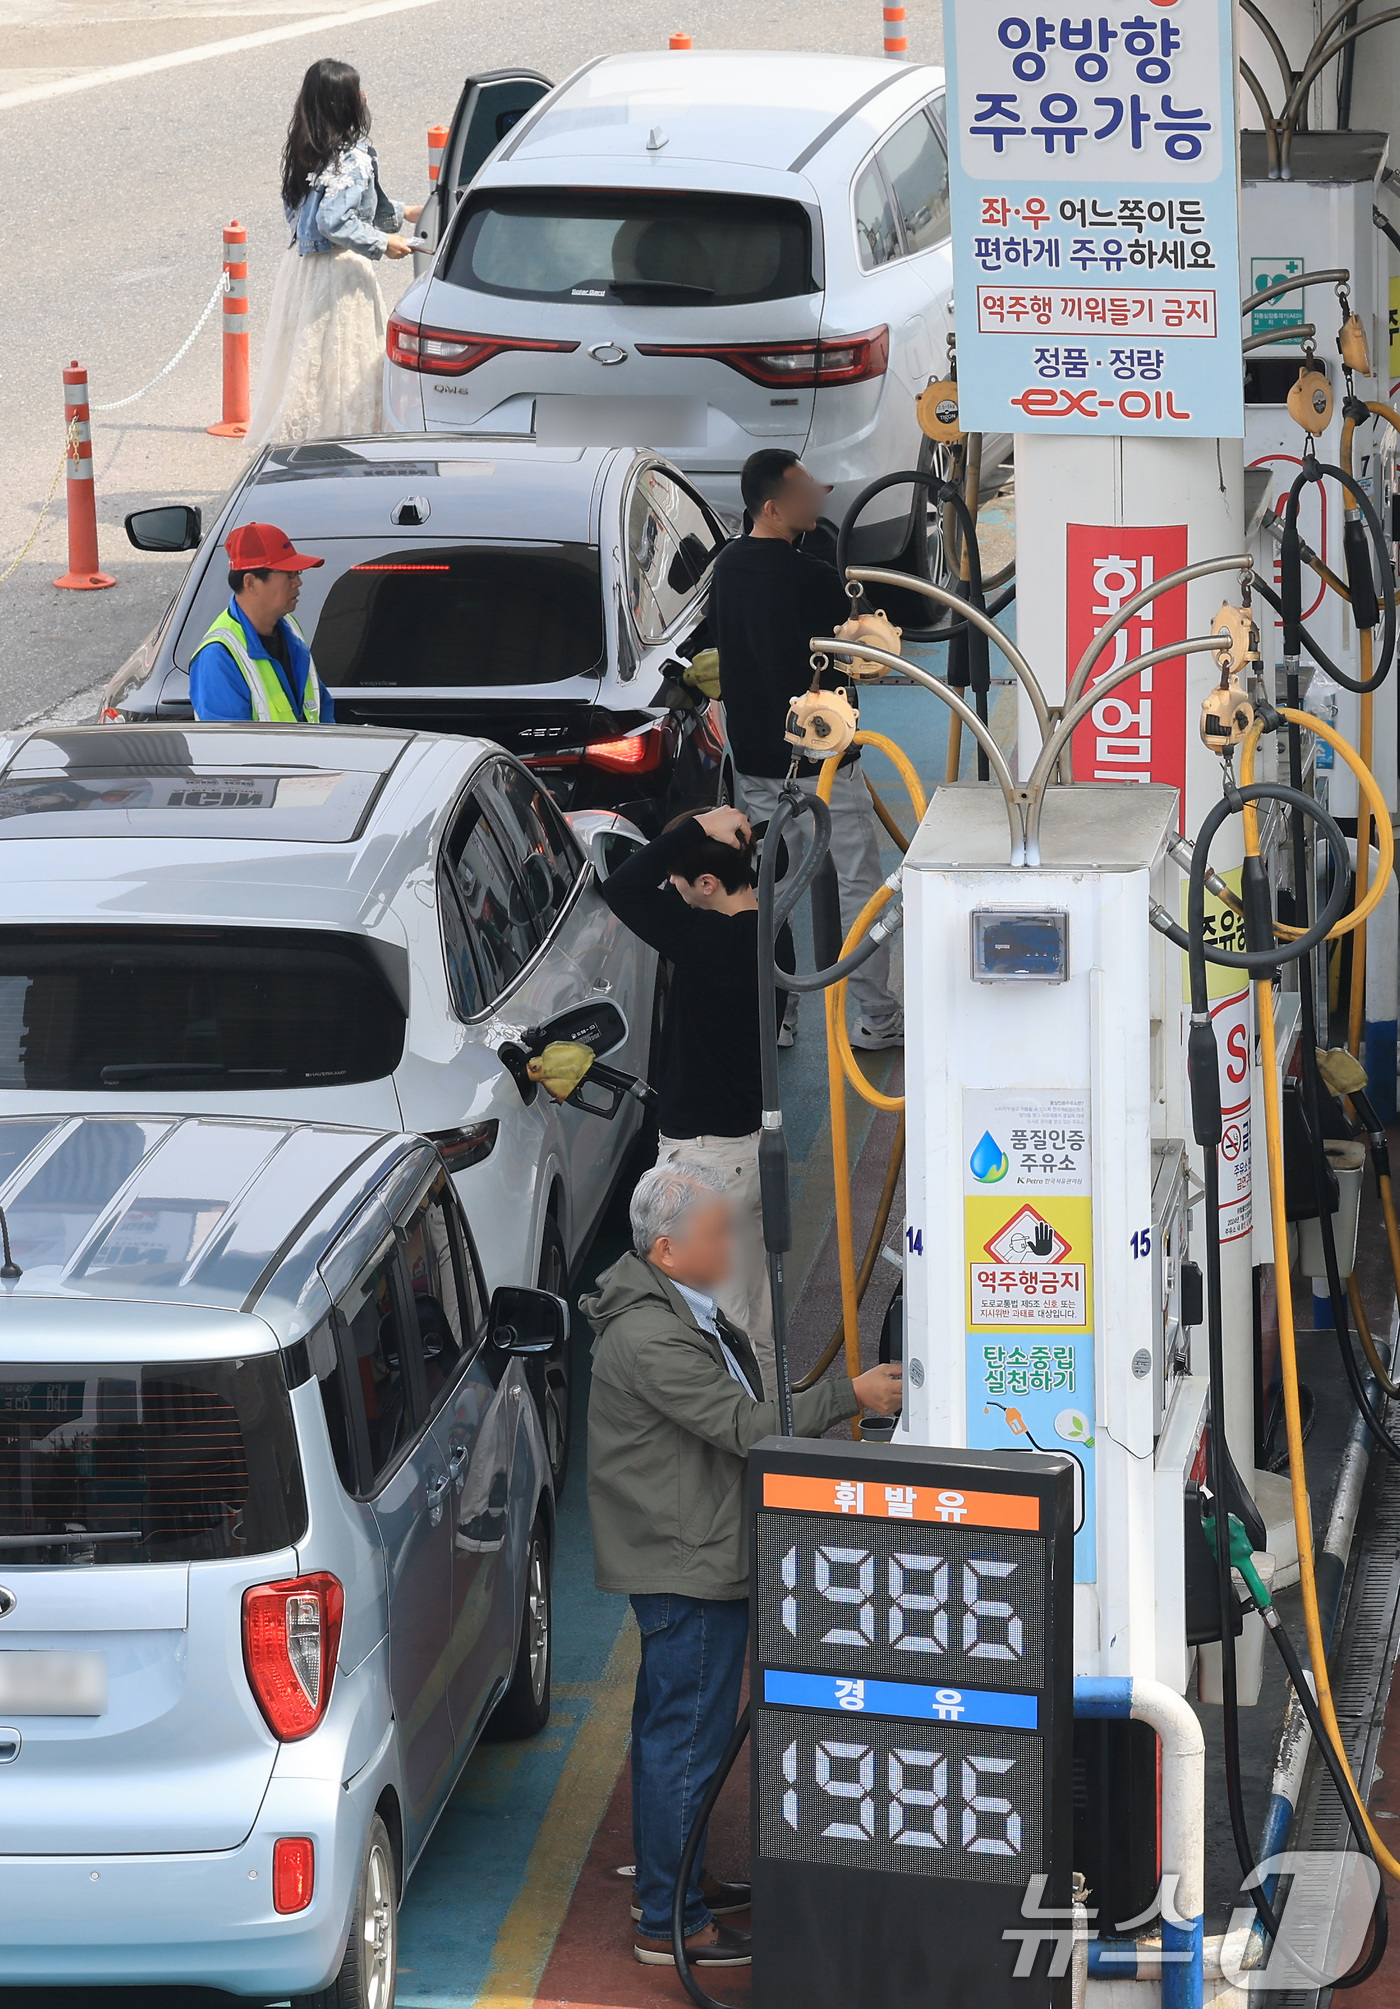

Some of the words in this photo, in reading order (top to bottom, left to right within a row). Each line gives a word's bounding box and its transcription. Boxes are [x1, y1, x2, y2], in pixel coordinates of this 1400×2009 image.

[997, 14, 1181, 84] 양방향
[969, 92, 1212, 161] 주유가능
[981, 197, 1051, 231] 좌·우
[1059, 198, 1205, 234] 어느쪽이든
[974, 236, 1060, 271] 편하게
[1069, 238, 1216, 271] 주유하세요
[982, 294, 1052, 325] 역주행
[1060, 296, 1154, 326] 끼워들기
[1161, 298, 1208, 328] 금지
[1033, 346, 1090, 379] 정품
[1108, 348, 1165, 381] 정량
[1010, 1129, 1086, 1151] 품질인증
[1020, 1153, 1077, 1173] 주유소
[905, 1225, 924, 1257] 14
[1130, 1227, 1151, 1260] 15
[977, 1270, 1080, 1295] 역주행금지
[980, 1299, 1018, 1309] 도로교통법
[1020, 1299, 1041, 1309] 제5조
[1042, 1299, 1059, 1309] 신호
[1060, 1299, 1076, 1309] 또는
[980, 1309, 1010, 1318] 지시위반
[1012, 1309, 1035, 1318] 과태료
[1037, 1309, 1077, 1319] 대상입니다.
[983, 1345, 1074, 1370] 탄소중립
[983, 1369, 1074, 1394] 실천하기
[780, 1545, 1024, 1661] 1986
[780, 1739, 1023, 1857] 1986
